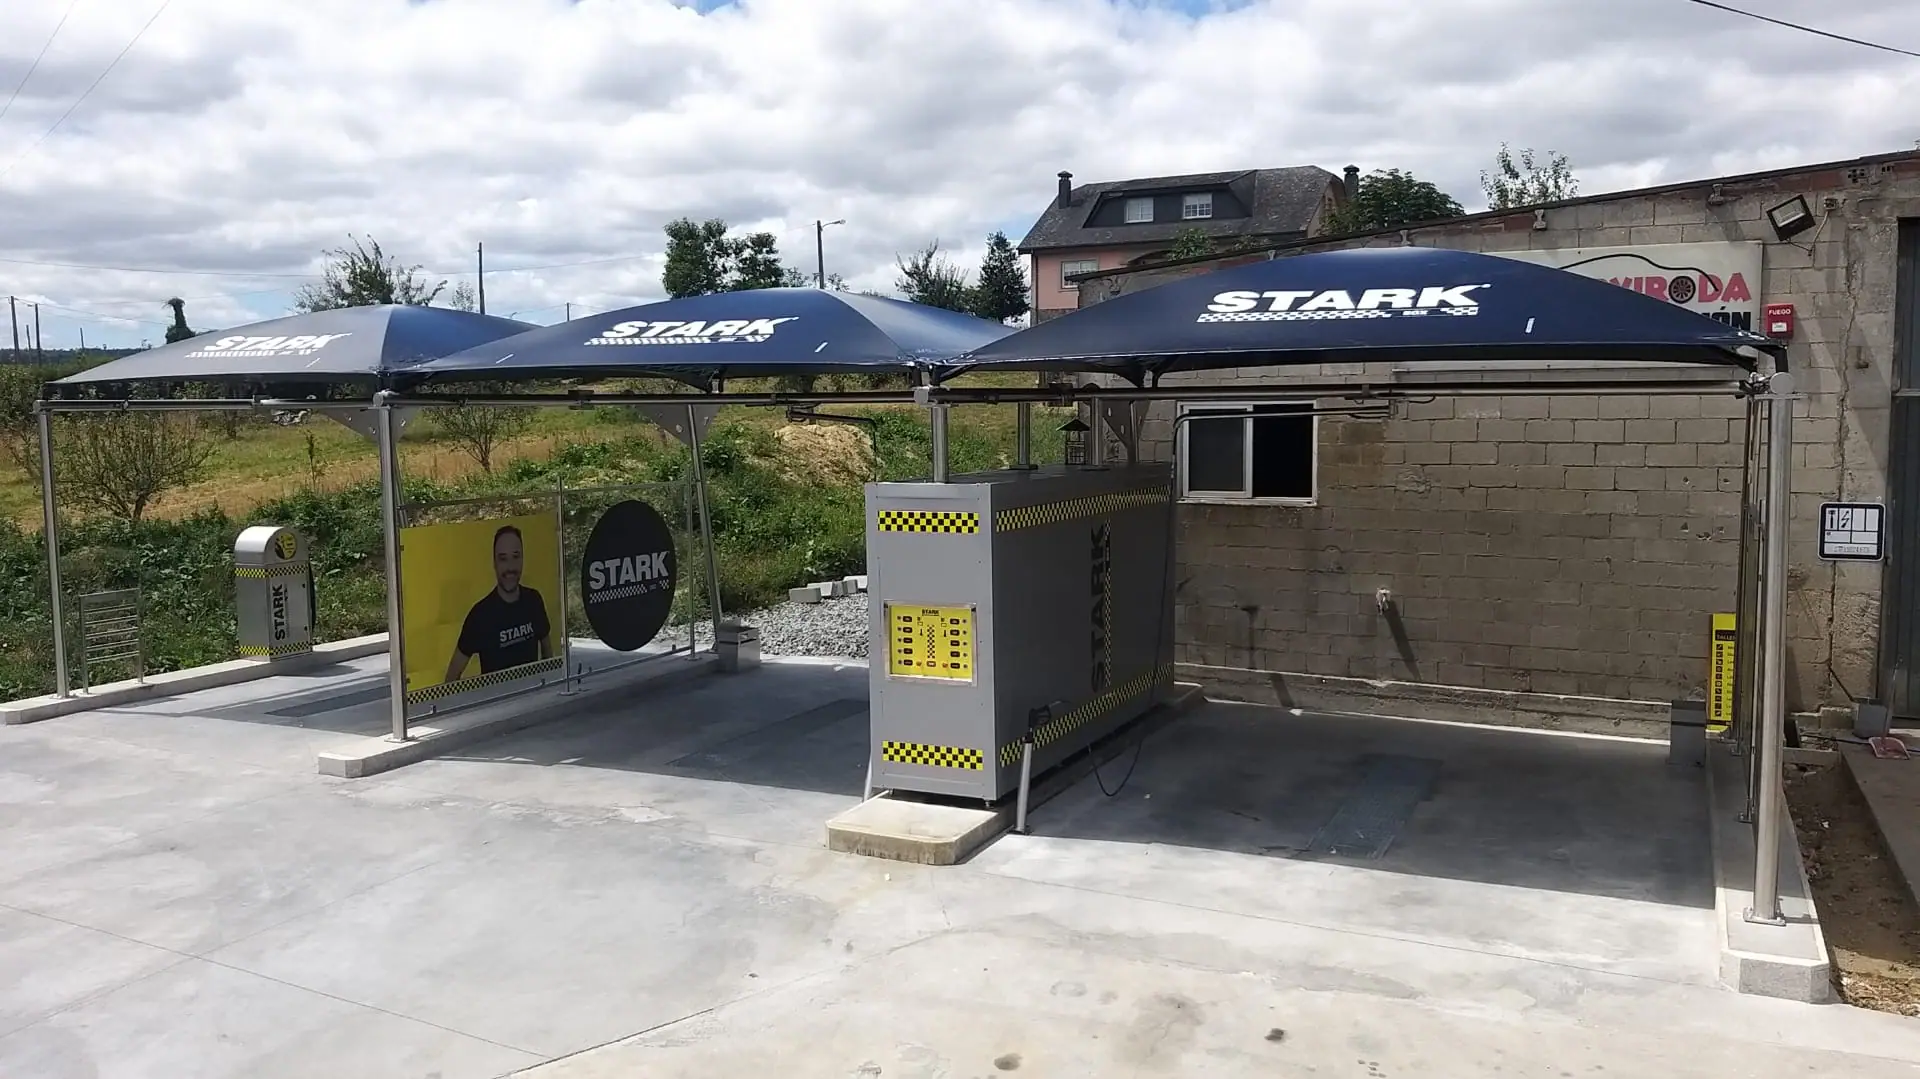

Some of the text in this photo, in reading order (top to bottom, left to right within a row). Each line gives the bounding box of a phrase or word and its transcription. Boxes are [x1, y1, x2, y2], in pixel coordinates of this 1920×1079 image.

[1207, 284, 1491, 312] STARK
[1768, 308, 1791, 316] FUEGO
[602, 316, 799, 338] STARK
[203, 332, 352, 351] STARK
[589, 551, 669, 590] STARK
[272, 584, 285, 640] STARK
[1090, 524, 1105, 693] STARK
[500, 622, 534, 642] STARK
